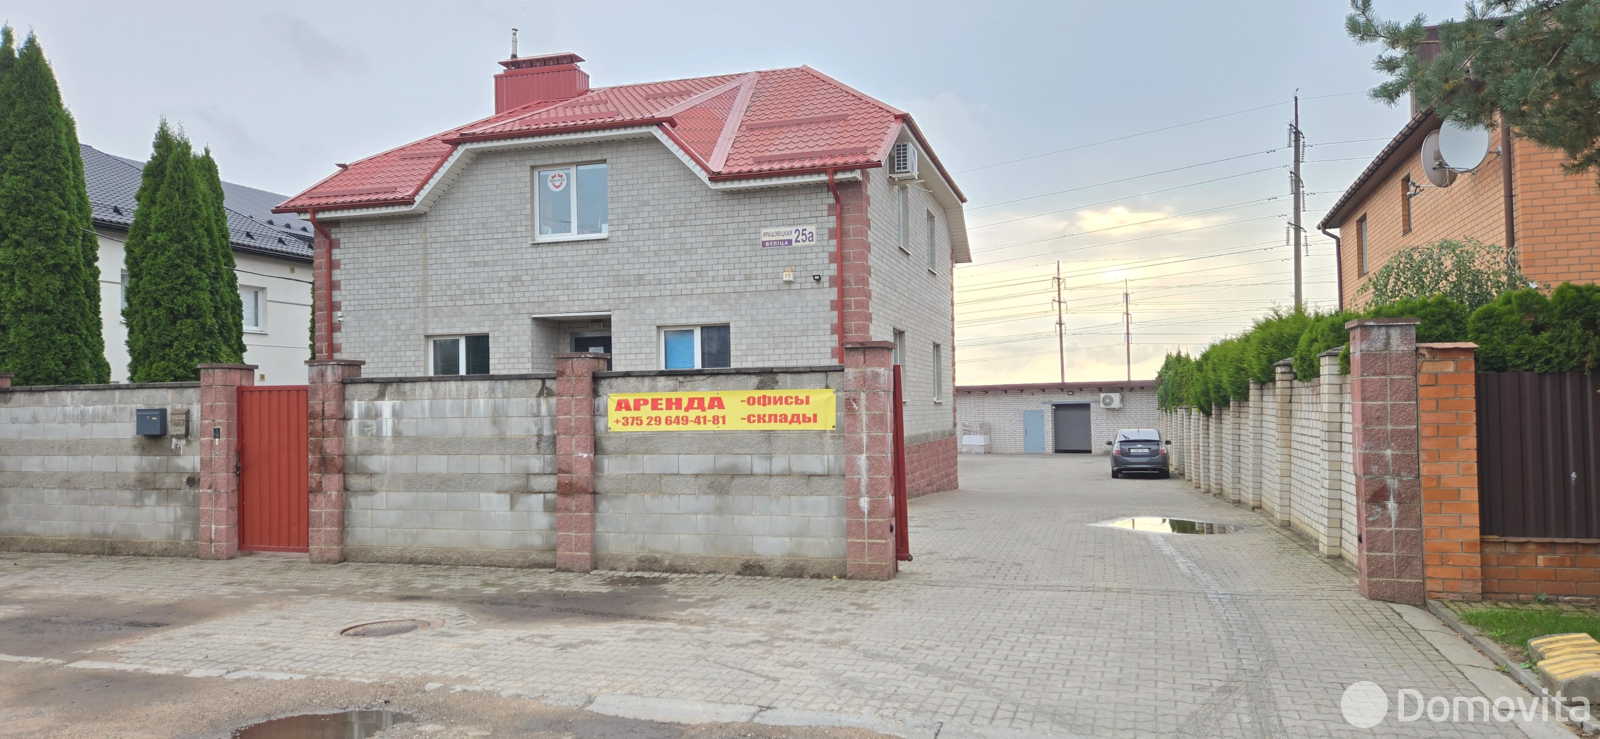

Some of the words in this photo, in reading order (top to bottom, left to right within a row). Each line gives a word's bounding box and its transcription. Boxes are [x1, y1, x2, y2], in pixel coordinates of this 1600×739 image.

[614, 396, 726, 412] АРЕНДА
[740, 394, 810, 407] -офисы
[613, 416, 643, 426] +375
[646, 415, 662, 426] 29
[664, 415, 726, 426] 649-41-81
[740, 413, 818, 425] -склады
